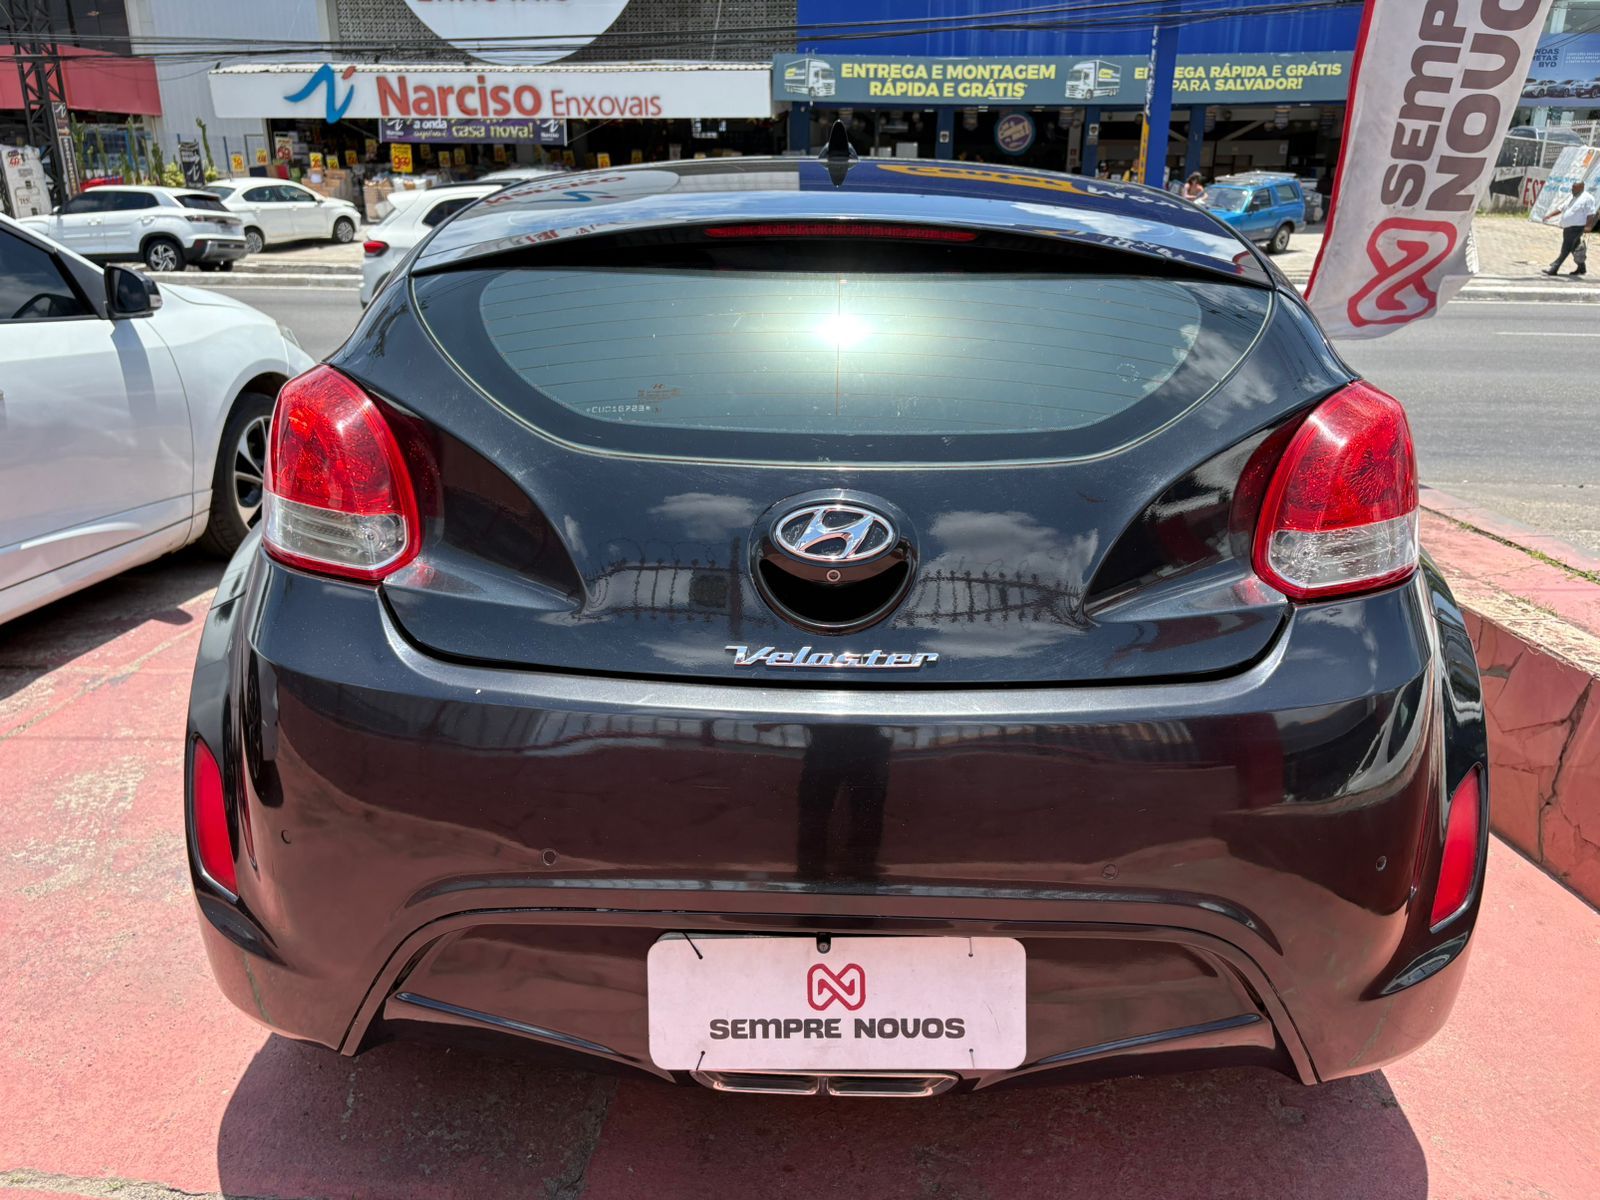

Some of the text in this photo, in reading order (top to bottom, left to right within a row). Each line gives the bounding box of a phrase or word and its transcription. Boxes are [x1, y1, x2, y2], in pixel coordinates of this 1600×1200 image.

[841, 63, 1056, 80] ENTREGA E MONTAGEM
[1210, 63, 1268, 78] RÁPIDA
[1272, 65, 1283, 77] E
[1286, 61, 1342, 76] GRÁTIS
[869, 79, 939, 97] RÁPIDA
[943, 82, 955, 97] E
[1172, 78, 1303, 91] PARA SALVADOR!
[376, 75, 662, 117] Narciso Enxovais
[422, 118, 447, 129] onda
[452, 126, 486, 138] casa
[490, 122, 533, 138] nova!
[1523, 177, 1546, 208] EST
[725, 646, 940, 668] Veloster
[709, 1018, 842, 1040] SEMPRE
